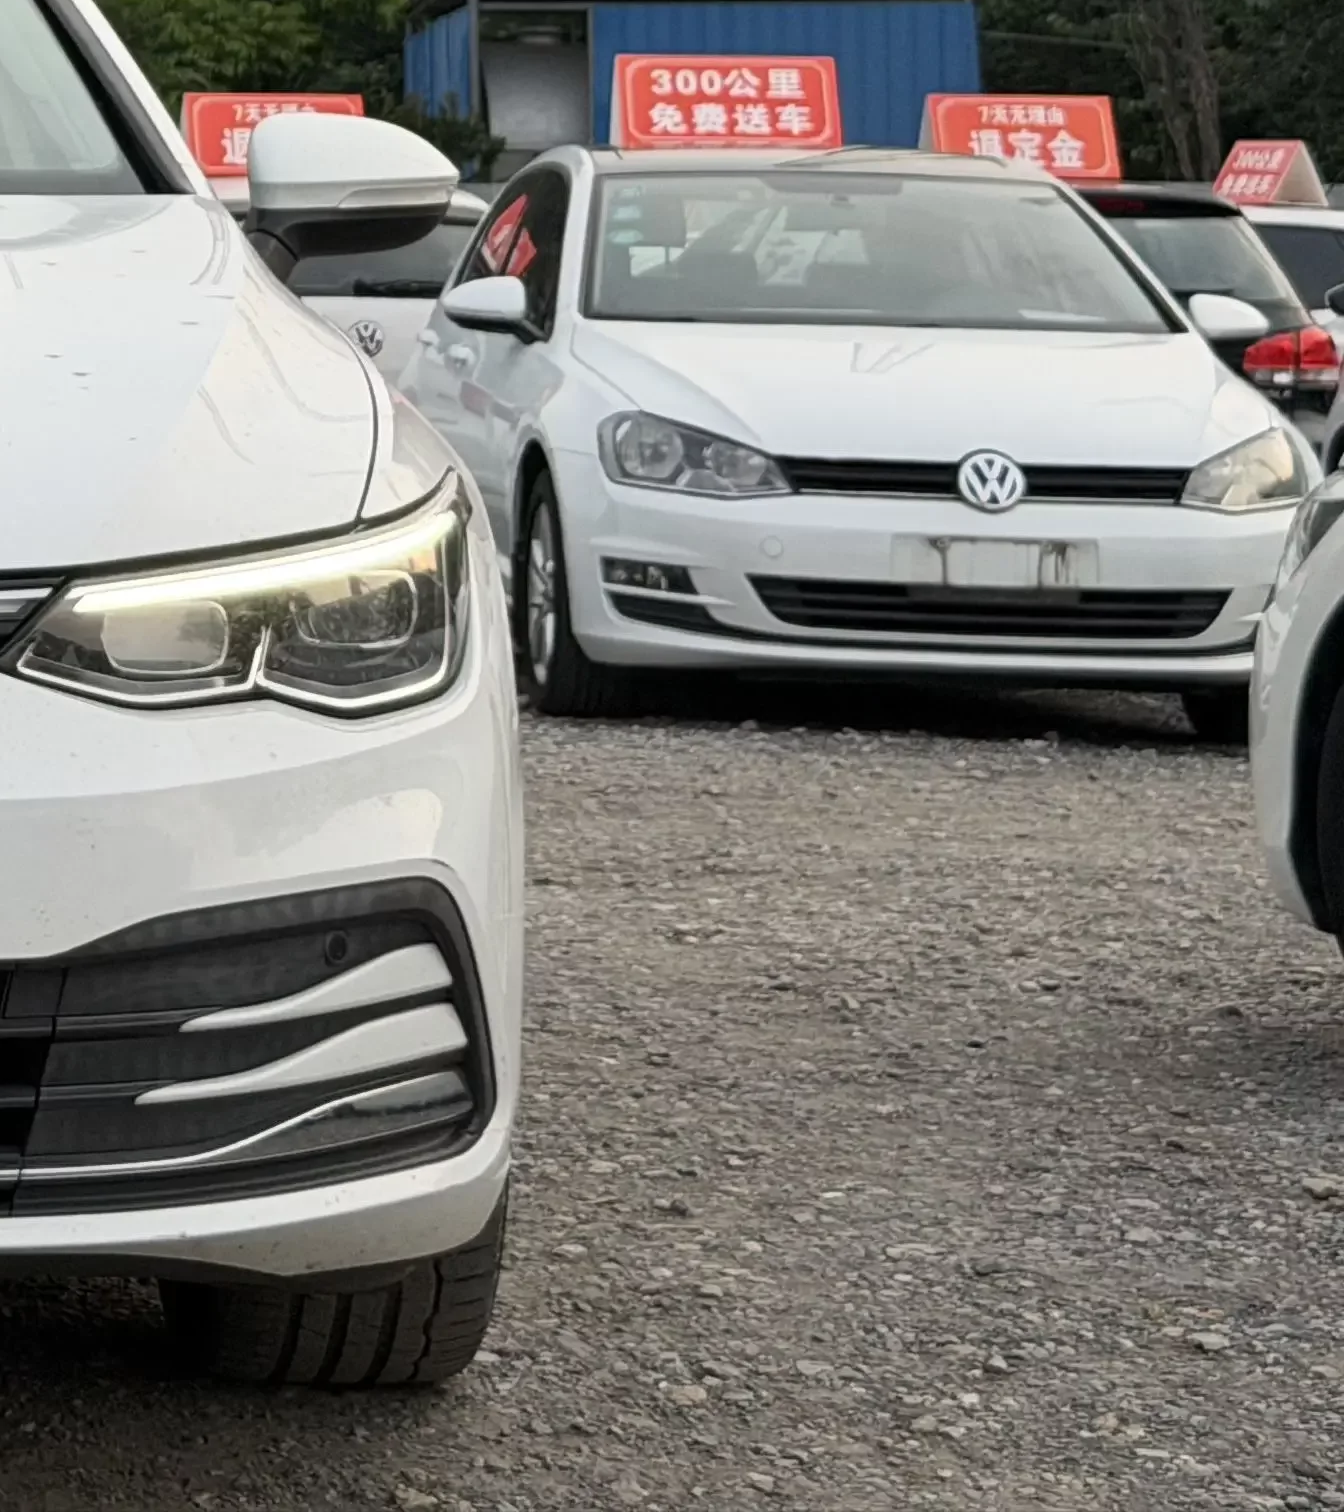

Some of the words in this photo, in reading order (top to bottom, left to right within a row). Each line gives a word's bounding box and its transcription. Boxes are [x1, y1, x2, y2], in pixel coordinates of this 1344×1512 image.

[650, 68, 806, 99] 300公里
[648, 102, 814, 135] 免费送车
